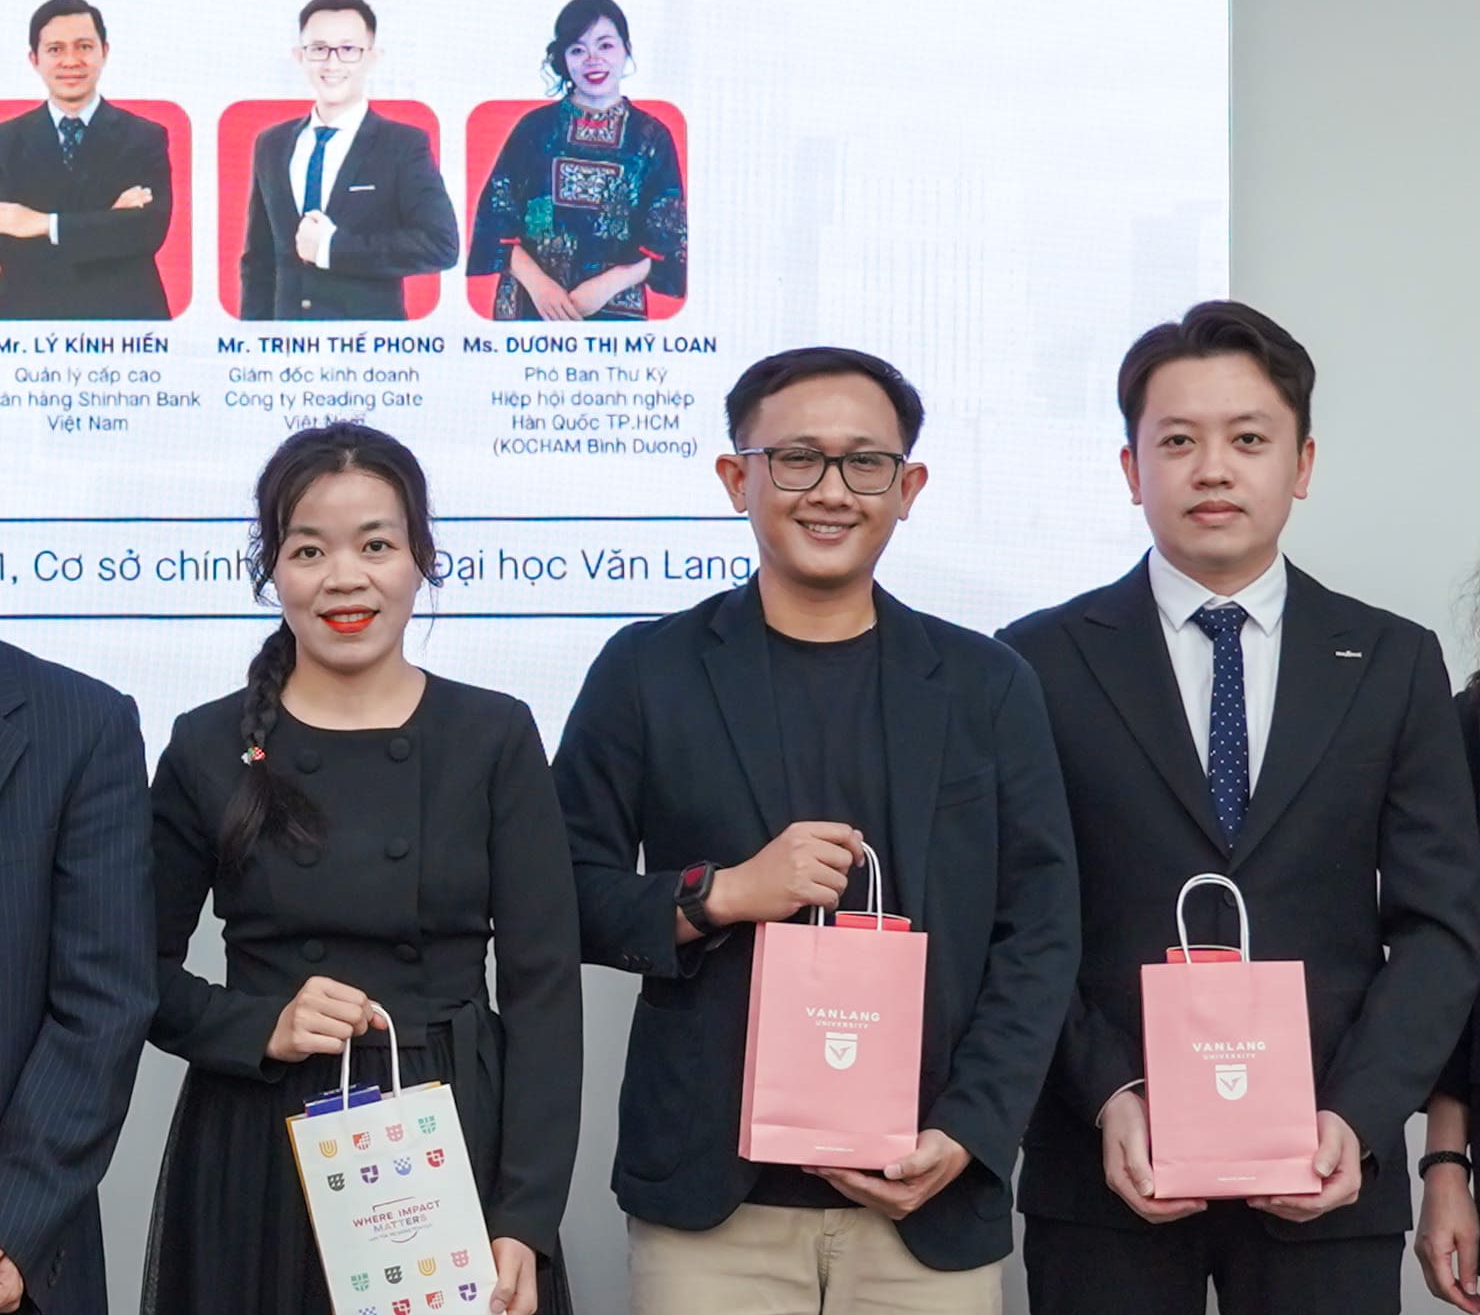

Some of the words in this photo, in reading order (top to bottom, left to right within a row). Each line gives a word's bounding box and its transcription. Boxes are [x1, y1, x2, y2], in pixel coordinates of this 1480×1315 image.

[35, 333, 58, 353] LÝ
[66, 333, 114, 353] KÍNH
[218, 338, 249, 353] Mr.
[258, 337, 319, 354] TRỊNH
[327, 332, 366, 353] THẾ
[374, 337, 444, 353] PHONG
[464, 337, 497, 352] Ms.
[507, 336, 577, 353] DƯƠNG
[584, 337, 617, 354] THỊ
[625, 334, 655, 352] MỸ
[664, 337, 716, 353] LOAN
[128, 370, 161, 383] cao
[321, 367, 357, 381] kinh
[363, 367, 419, 382] doanh
[566, 367, 599, 382] Ban
[78, 391, 150, 407] Shinhan
[157, 391, 200, 406] Bank
[280, 393, 295, 410] ty
[303, 391, 376, 412] Reading
[382, 391, 423, 406] Gate
[571, 391, 627, 406] doanh
[89, 416, 128, 431] Nam
[606, 414, 679, 430] TP.HCM
[493, 438, 581, 456] (KOCHAM
[499, 548, 567, 586] học
[581, 549, 648, 580] Văn
[806, 1007, 880, 1021] VANLANG
[1192, 1041, 1266, 1053] VANLANG
[352, 1211, 393, 1228] WHERE
[398, 1199, 440, 1217] IMPACT
[373, 1213, 427, 1233] MATTERS
